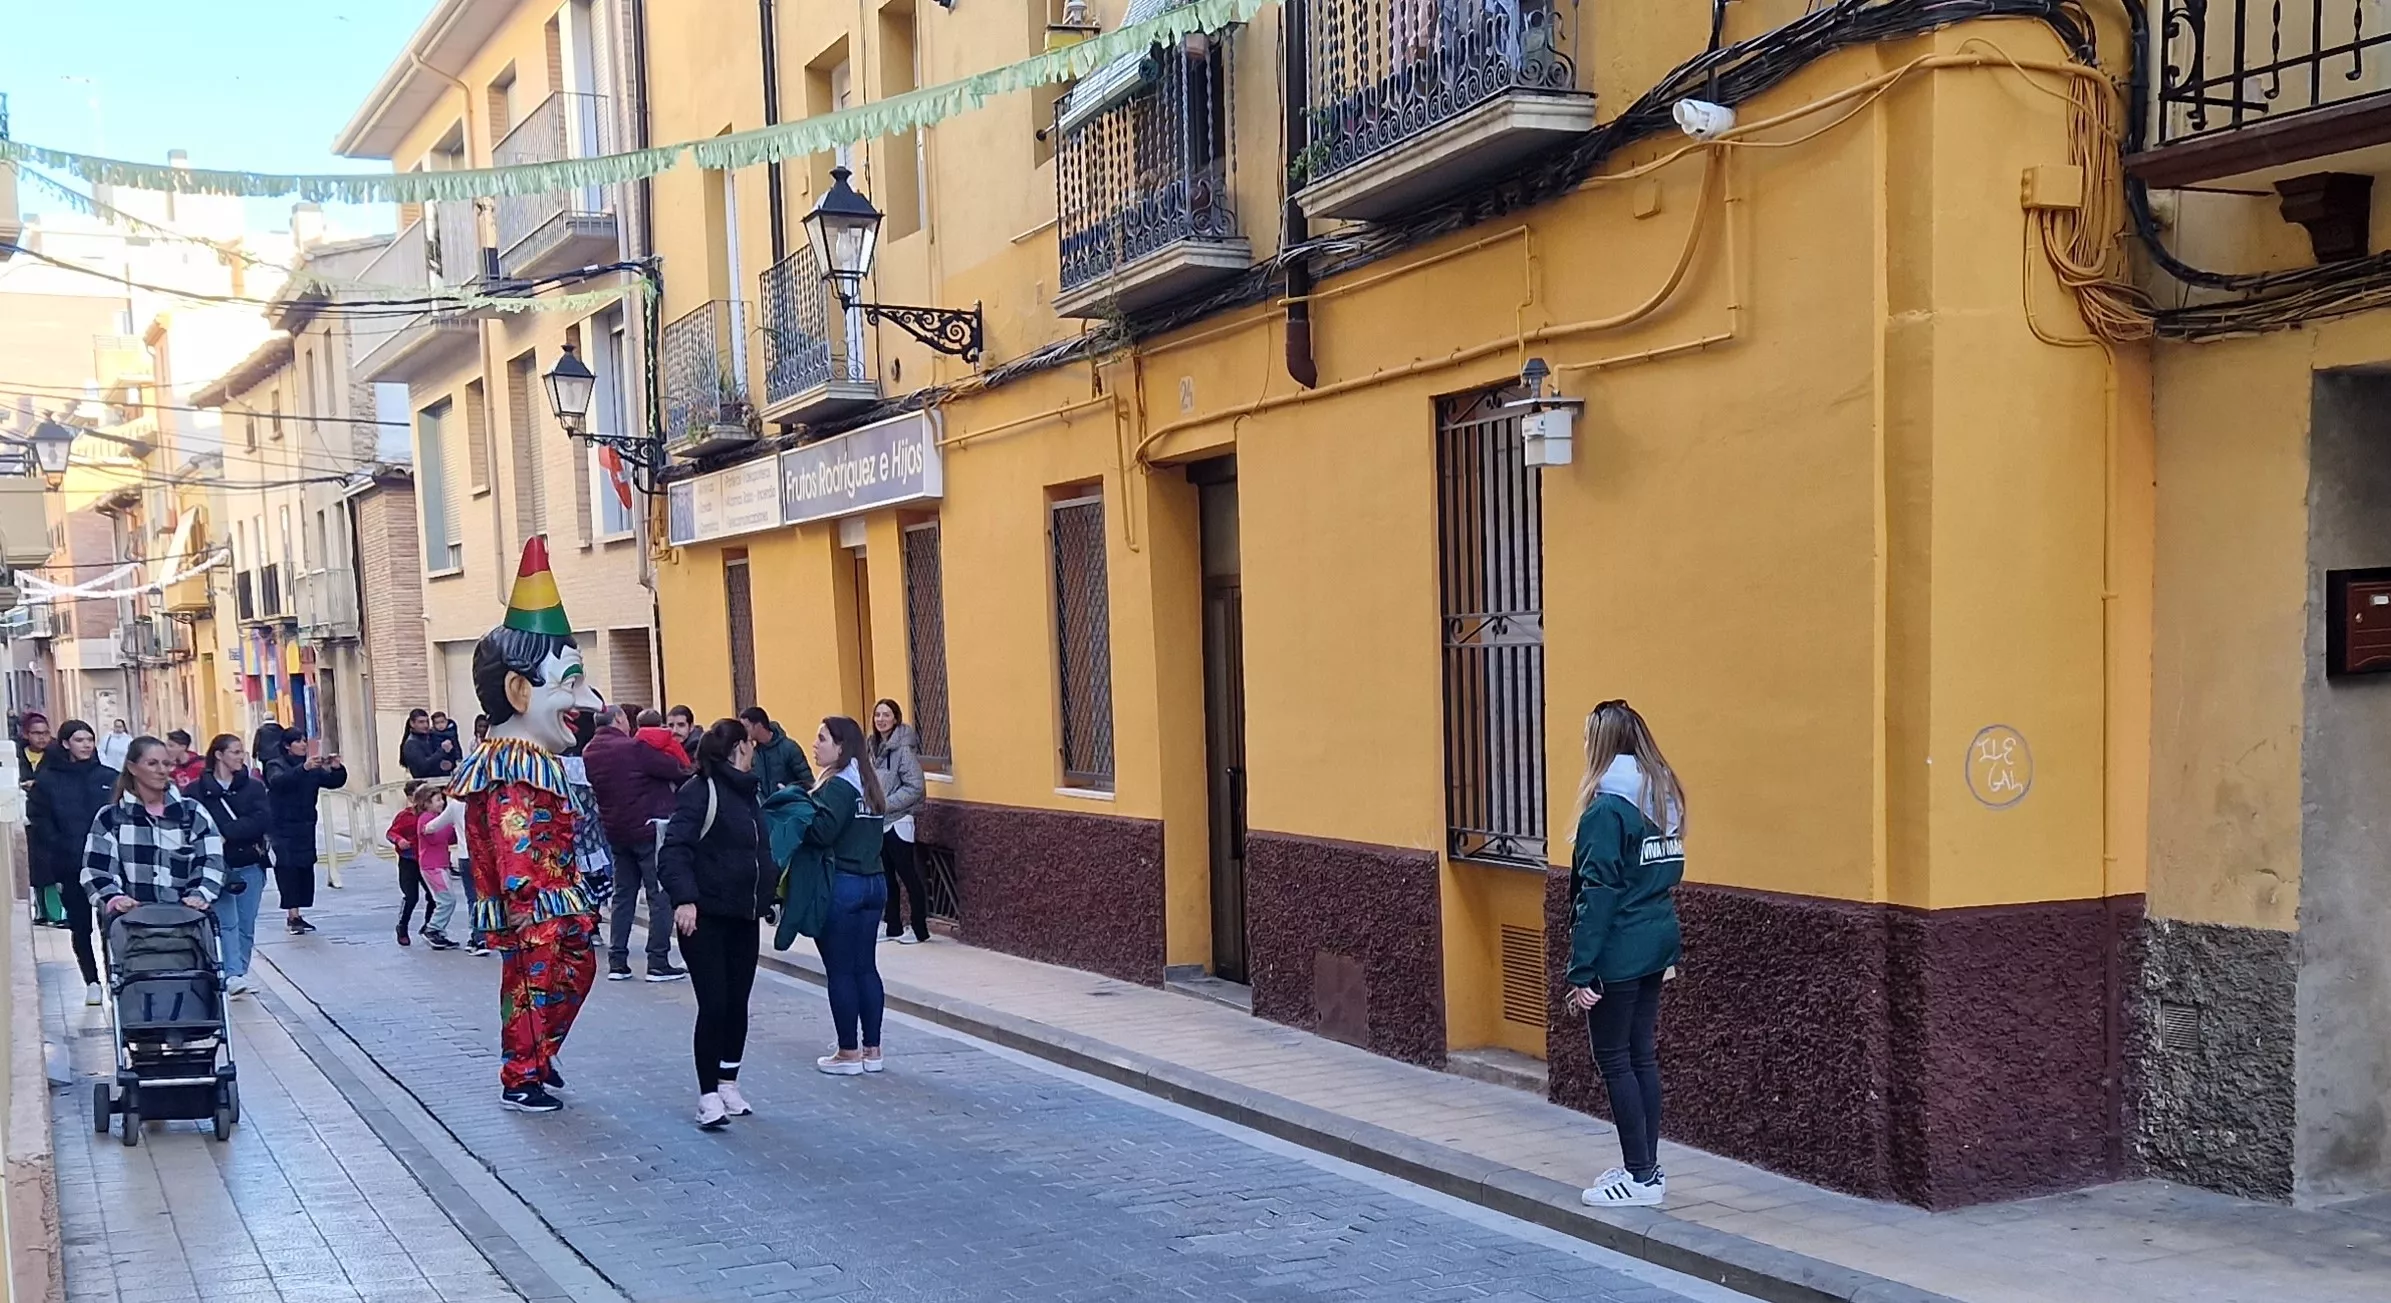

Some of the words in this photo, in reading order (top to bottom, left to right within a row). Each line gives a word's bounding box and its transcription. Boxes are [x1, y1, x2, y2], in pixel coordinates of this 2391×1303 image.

[1180, 378, 1193, 410] 24
[786, 467, 817, 505] Frutos
[819, 451, 876, 498] Rodríguez
[879, 451, 889, 481] e
[892, 438, 922, 485] Hijos
